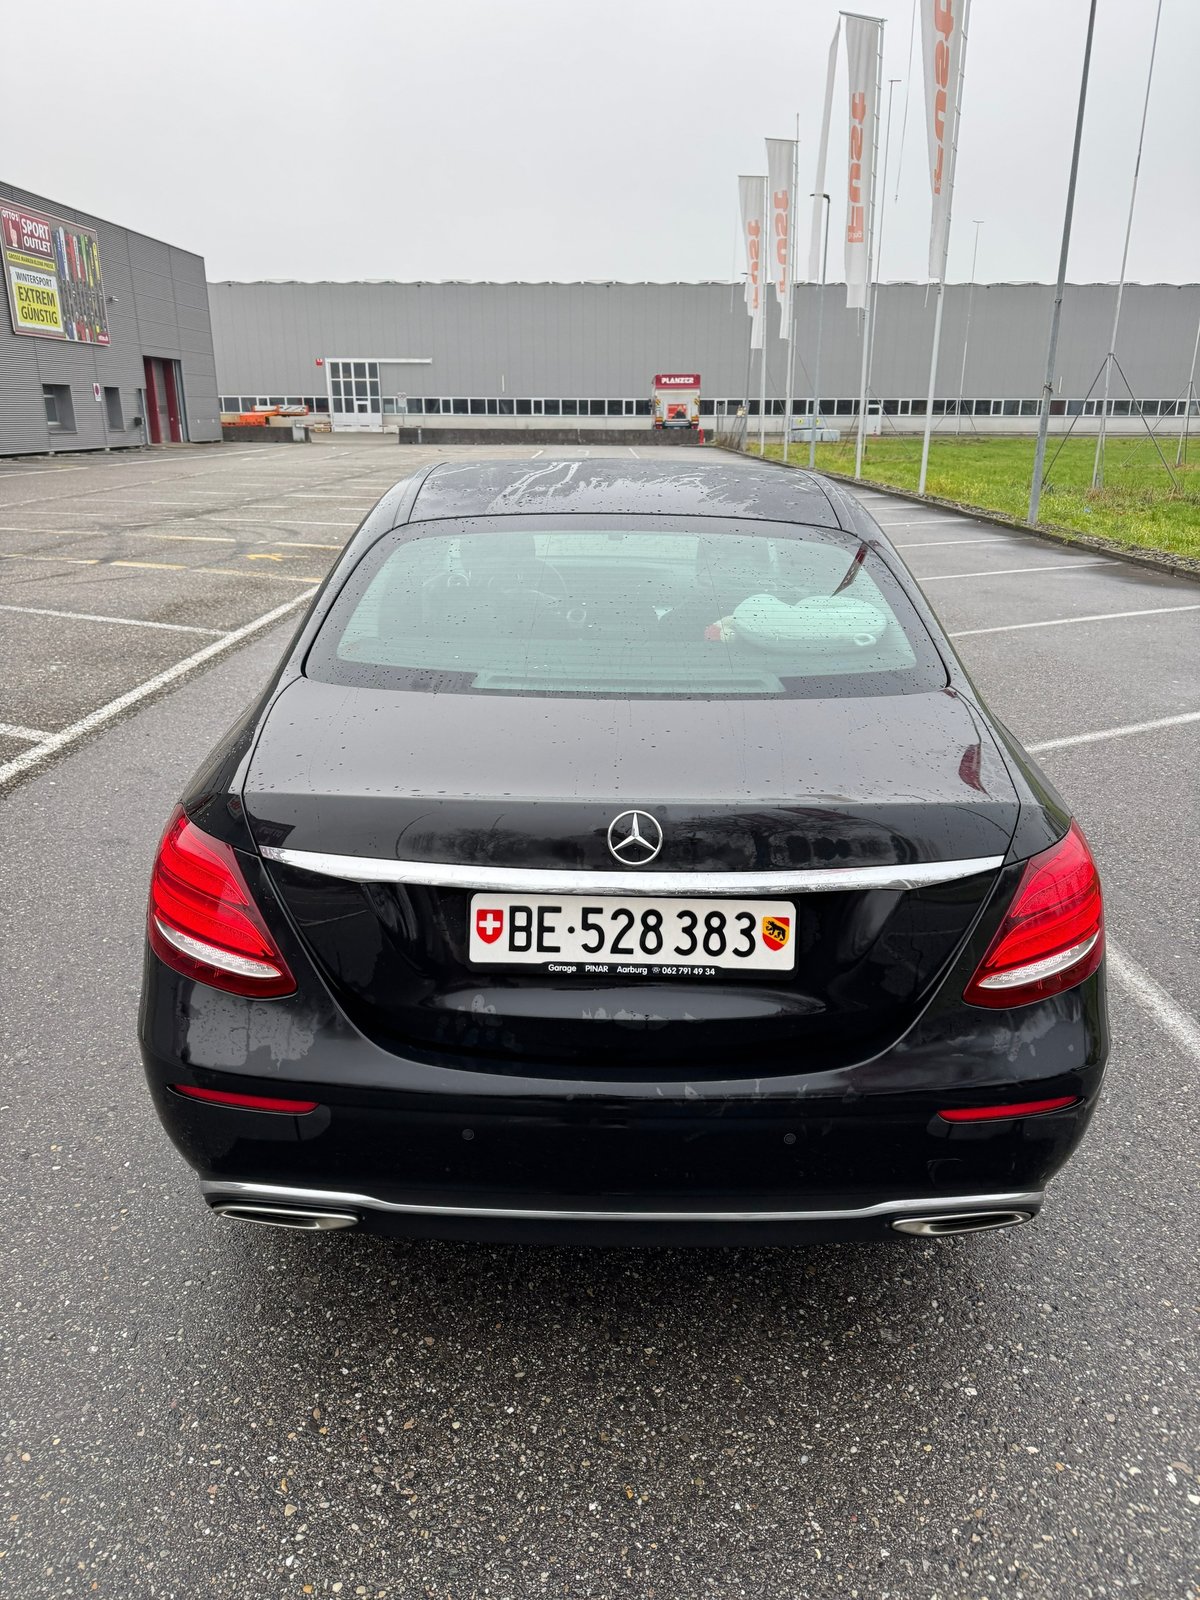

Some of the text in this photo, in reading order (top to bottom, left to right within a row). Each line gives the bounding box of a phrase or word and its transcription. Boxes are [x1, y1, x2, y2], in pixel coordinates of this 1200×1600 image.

[21, 218, 49, 240] SPORT
[23, 235, 51, 253] OUTLET
[15, 271, 52, 287] WINTERSPORT
[17, 286, 56, 308] EXTREM
[21, 304, 58, 325] GÜNSTIG
[548, 963, 716, 976] Garage PINAR Aarburg 062 791 49 34
